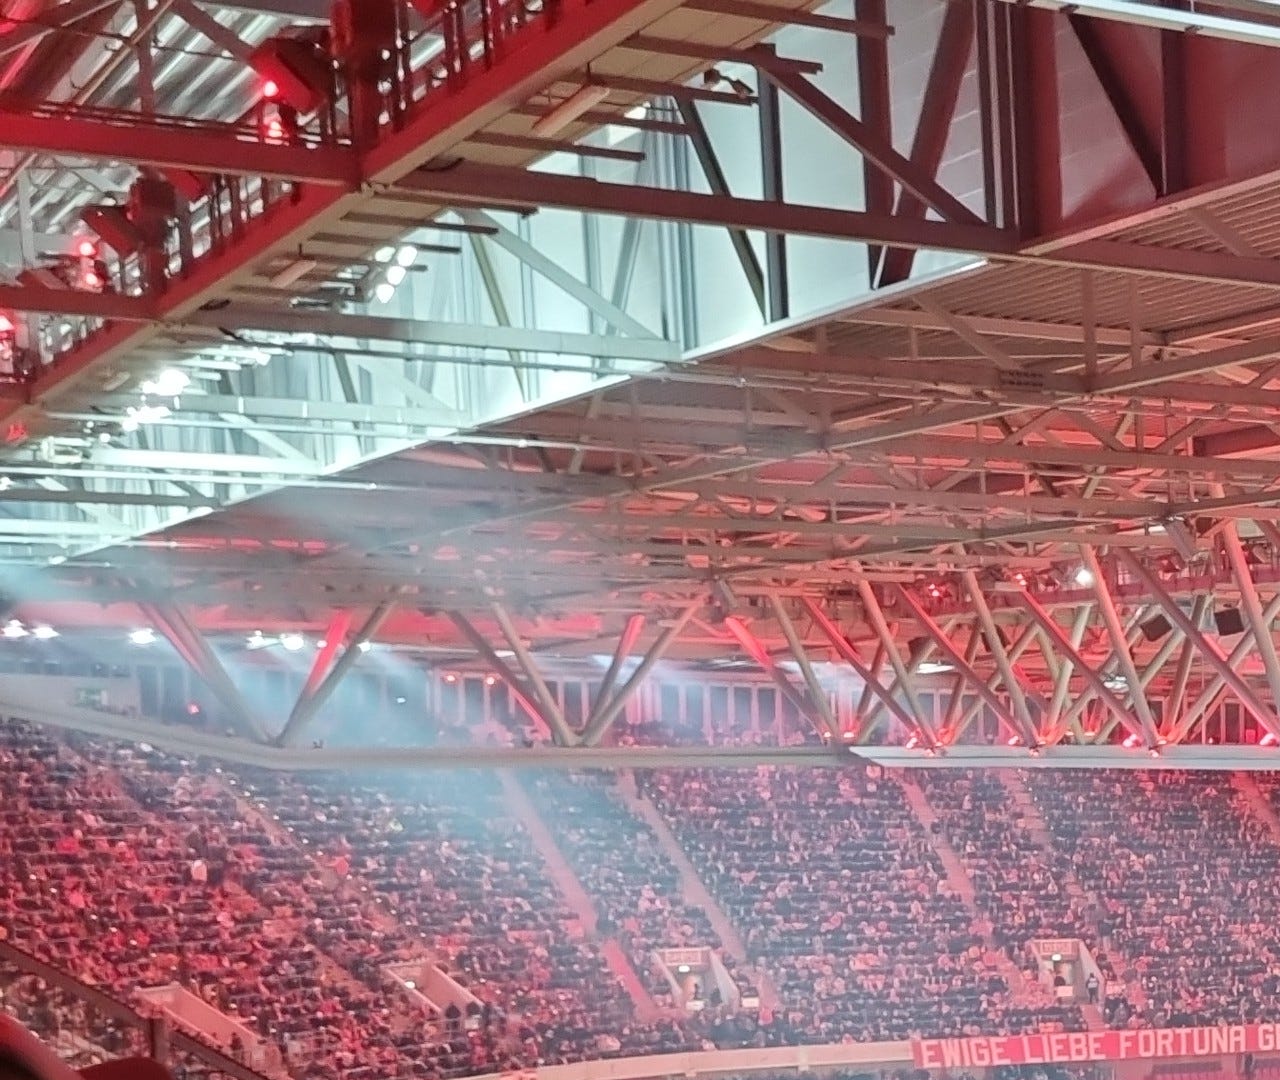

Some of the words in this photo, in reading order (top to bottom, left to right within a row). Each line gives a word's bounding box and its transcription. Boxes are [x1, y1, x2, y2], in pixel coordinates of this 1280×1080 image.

[921, 1037, 1010, 1068] EWIGE
[1022, 1032, 1103, 1063] LIEBE
[1119, 1027, 1246, 1059] FORTUNA
